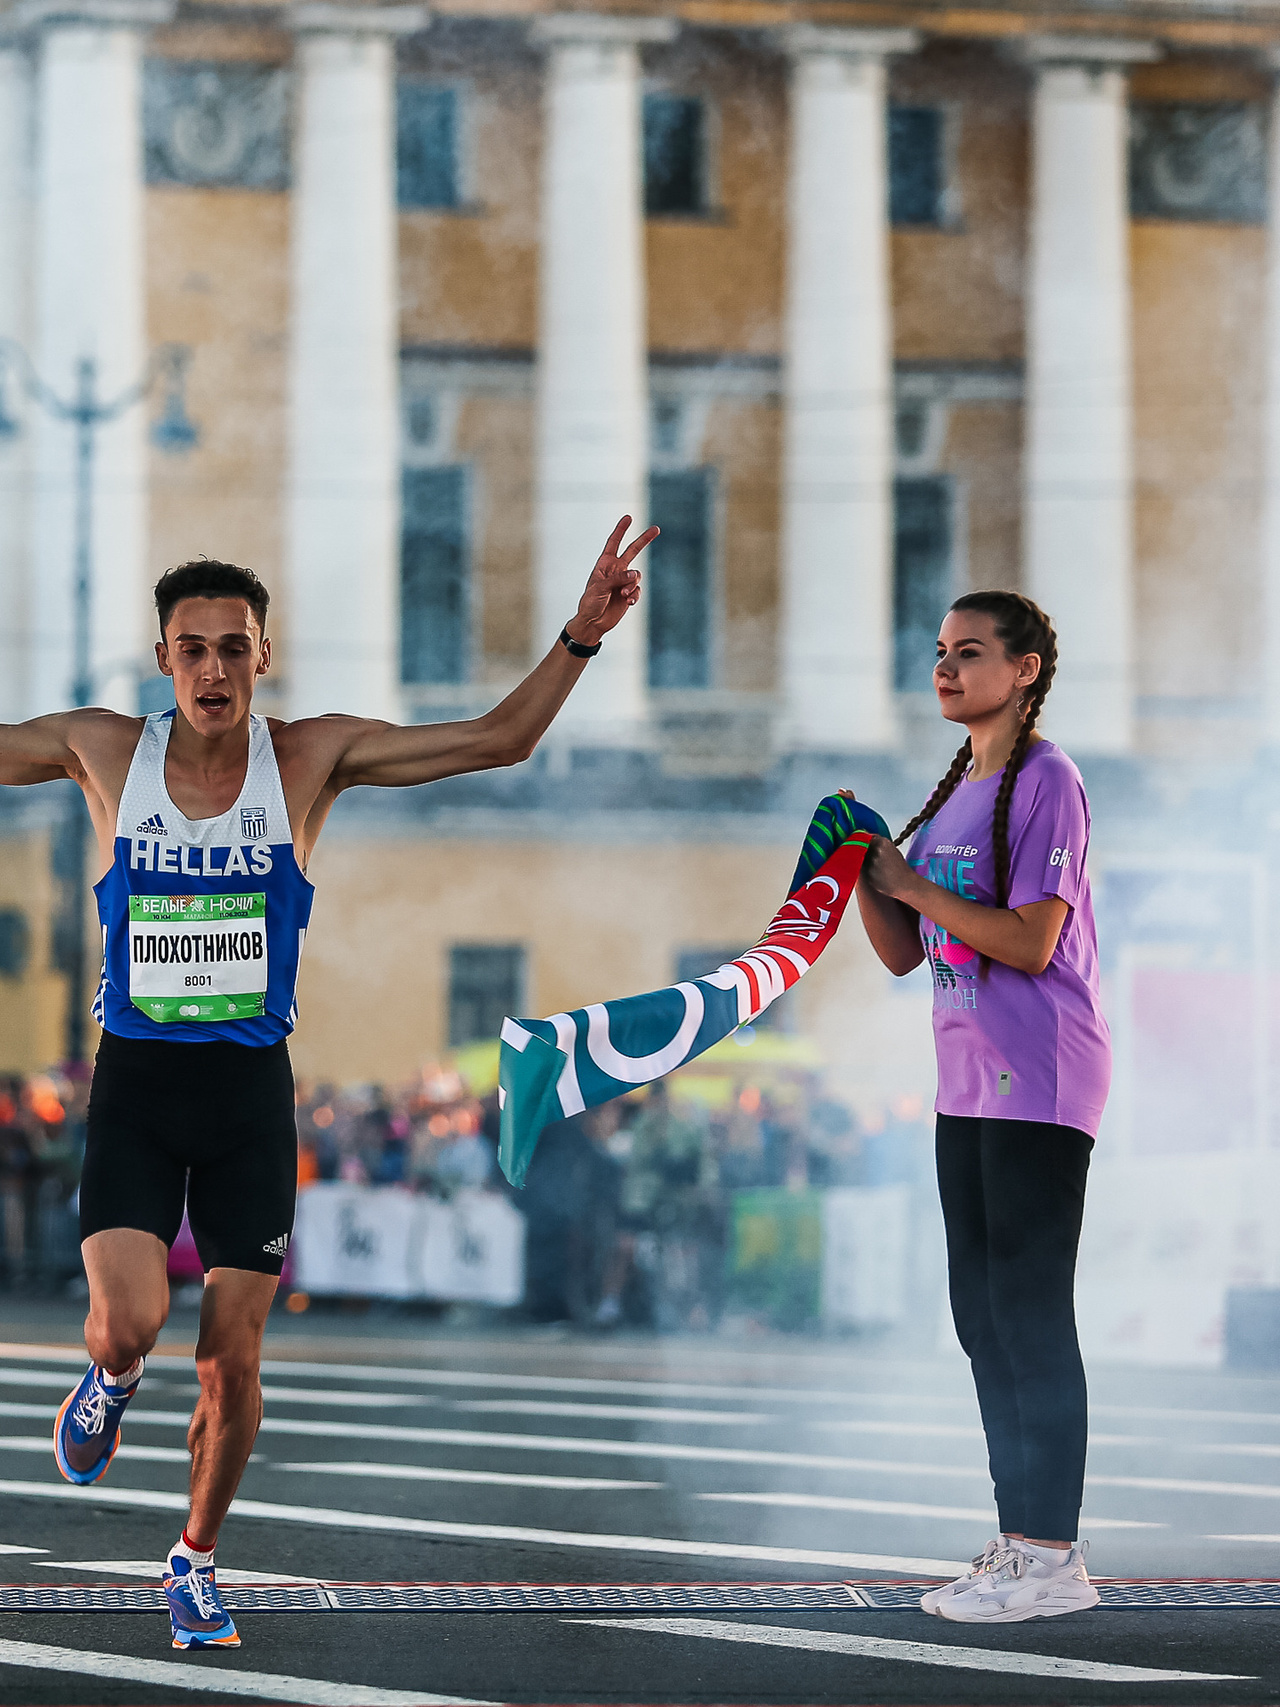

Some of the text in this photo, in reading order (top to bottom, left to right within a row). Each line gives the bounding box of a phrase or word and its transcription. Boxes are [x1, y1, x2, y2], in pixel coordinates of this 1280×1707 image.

[136, 825, 168, 836] adidas
[130, 840, 273, 876] HELLAS
[143, 897, 253, 913] БЕЛЫЕ НОЧИ
[133, 931, 263, 964] ПЛОХОТНИКОВ
[184, 975, 212, 987] 8001
[263, 1244, 287, 1258] adid
